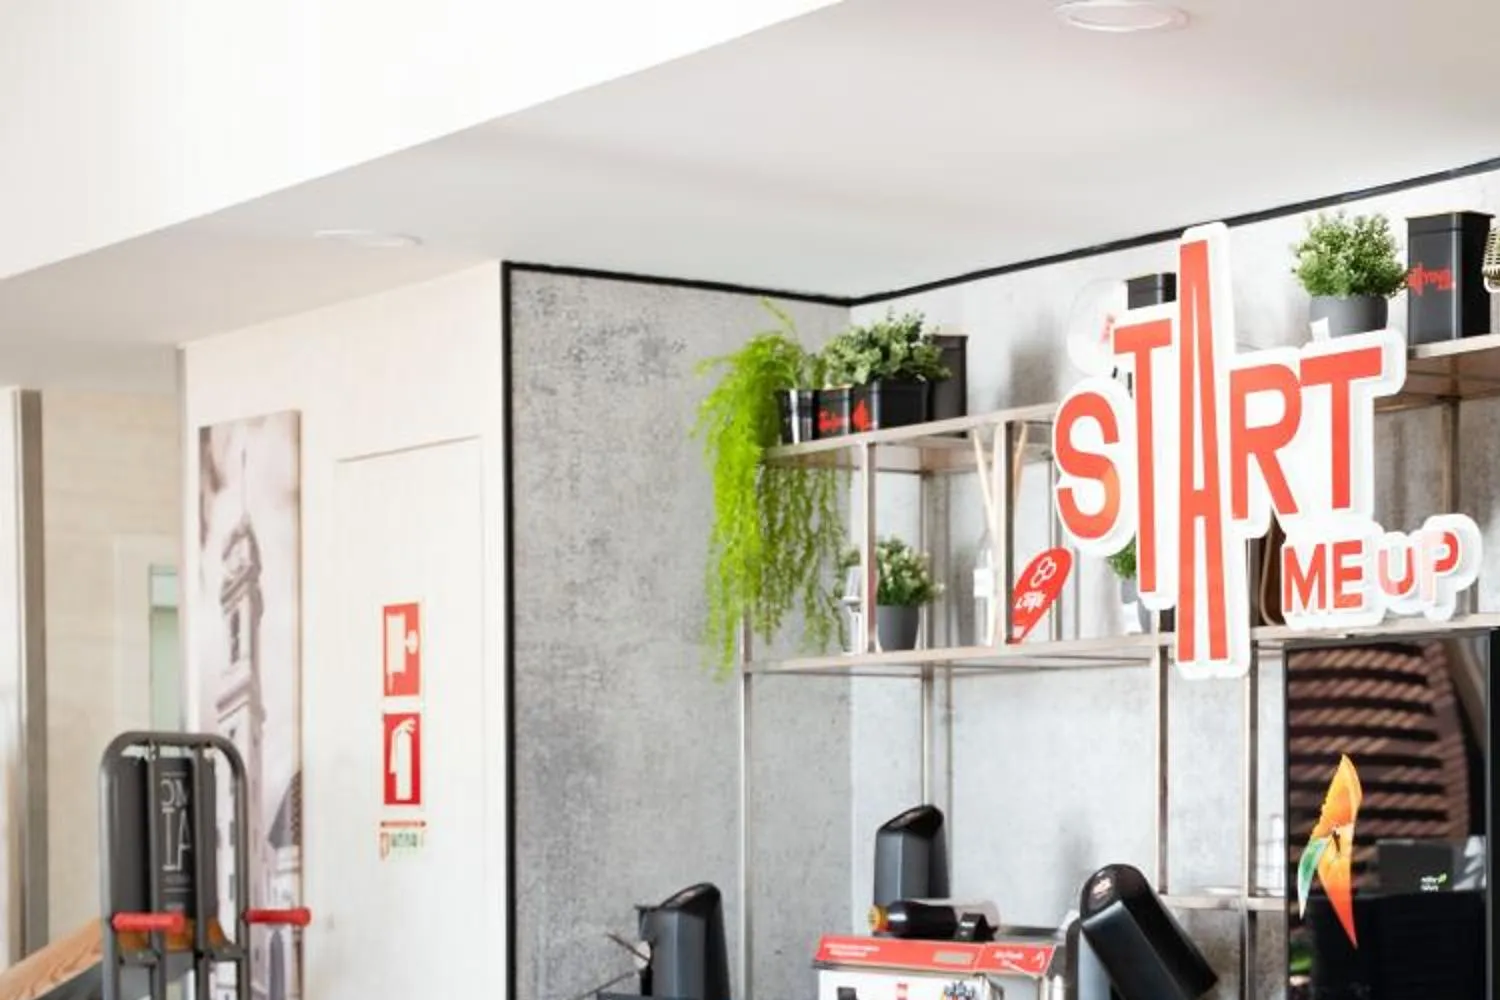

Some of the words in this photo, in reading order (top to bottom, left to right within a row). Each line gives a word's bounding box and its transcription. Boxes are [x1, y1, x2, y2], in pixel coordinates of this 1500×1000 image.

[1055, 239, 1383, 661] START
[1284, 540, 1364, 612] ME
[1377, 529, 1460, 602] UP
